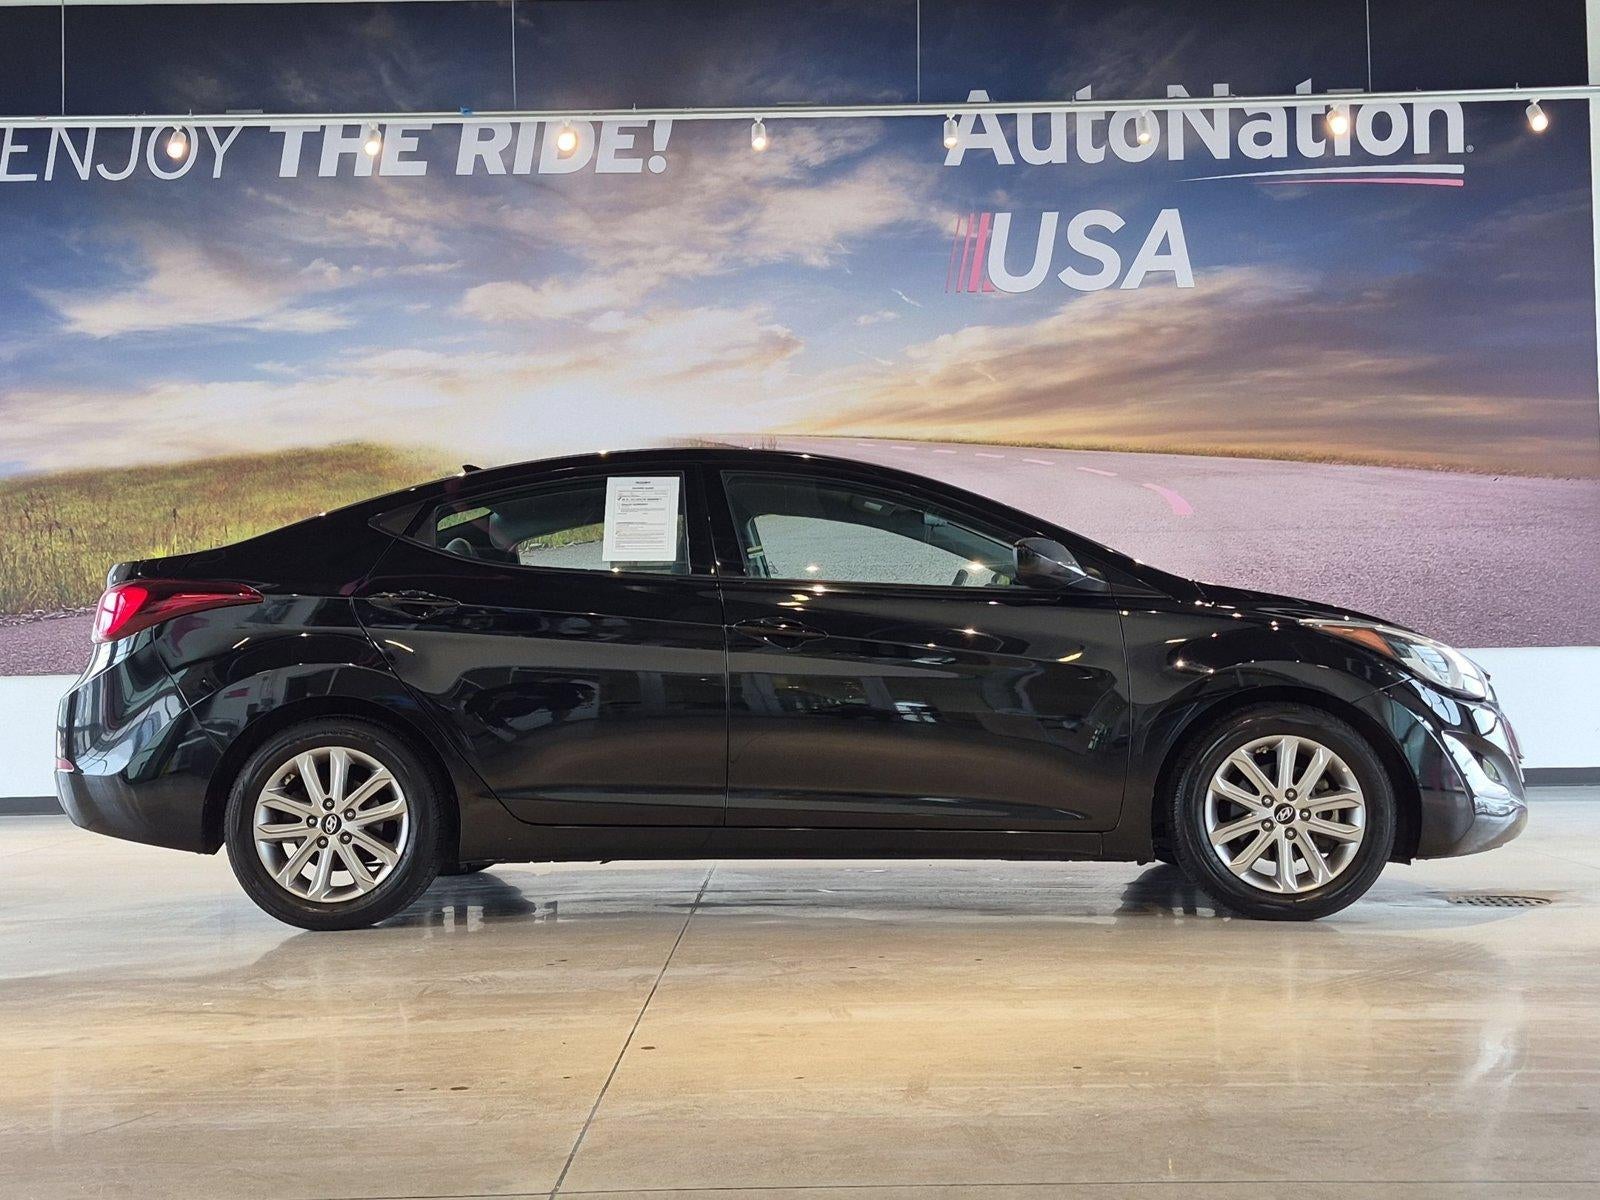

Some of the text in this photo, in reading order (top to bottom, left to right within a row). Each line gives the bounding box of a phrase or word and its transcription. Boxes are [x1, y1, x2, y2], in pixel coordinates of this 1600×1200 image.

[0, 119, 673, 182] ENJOY THE RIDE!
[944, 78, 1465, 166] AutoNation
[987, 208, 1195, 293] USA
